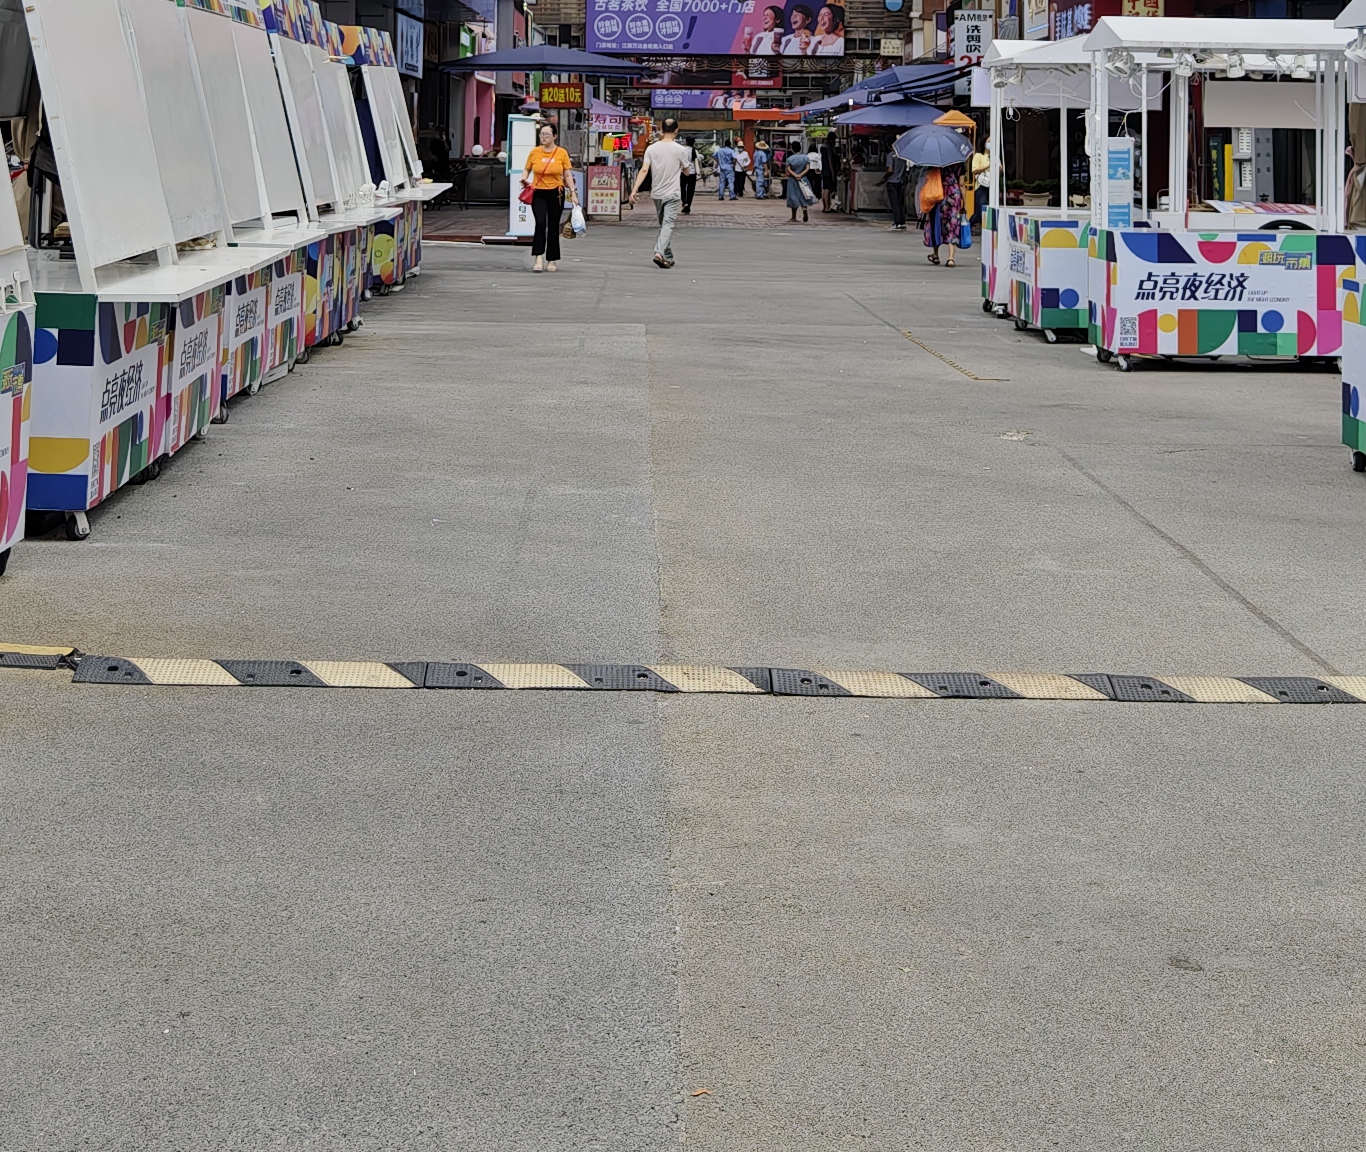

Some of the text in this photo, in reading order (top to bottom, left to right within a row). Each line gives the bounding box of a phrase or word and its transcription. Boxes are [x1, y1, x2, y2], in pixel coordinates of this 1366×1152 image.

[966, 24, 982, 54] 洗剪吹
[541, 87, 582, 103] 满20送10元
[1134, 271, 1251, 302] 点亮夜经济
